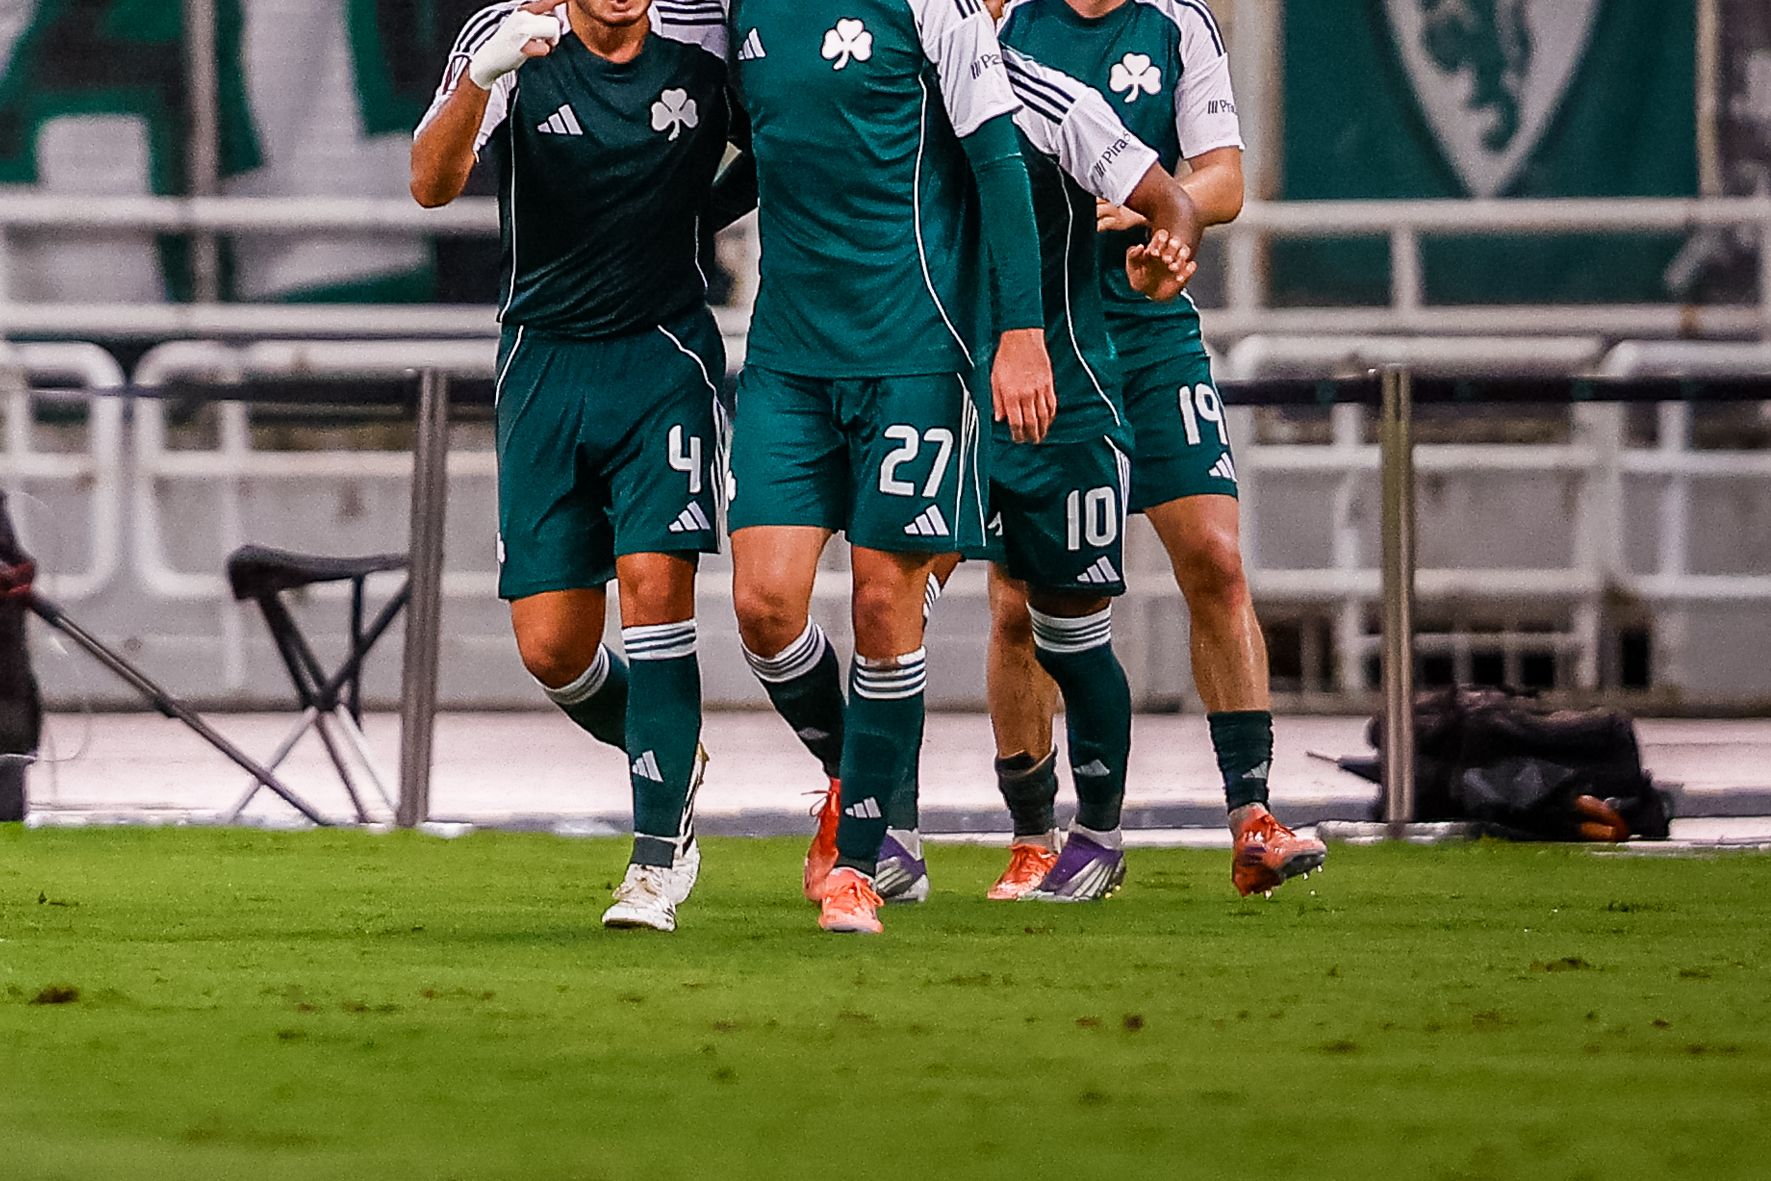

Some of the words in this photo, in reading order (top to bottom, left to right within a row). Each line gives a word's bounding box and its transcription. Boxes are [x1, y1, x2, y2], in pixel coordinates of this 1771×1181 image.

[1178, 382, 1229, 447] 19
[667, 424, 702, 494] 4
[878, 424, 954, 498] 27
[1065, 486, 1117, 552] 10
